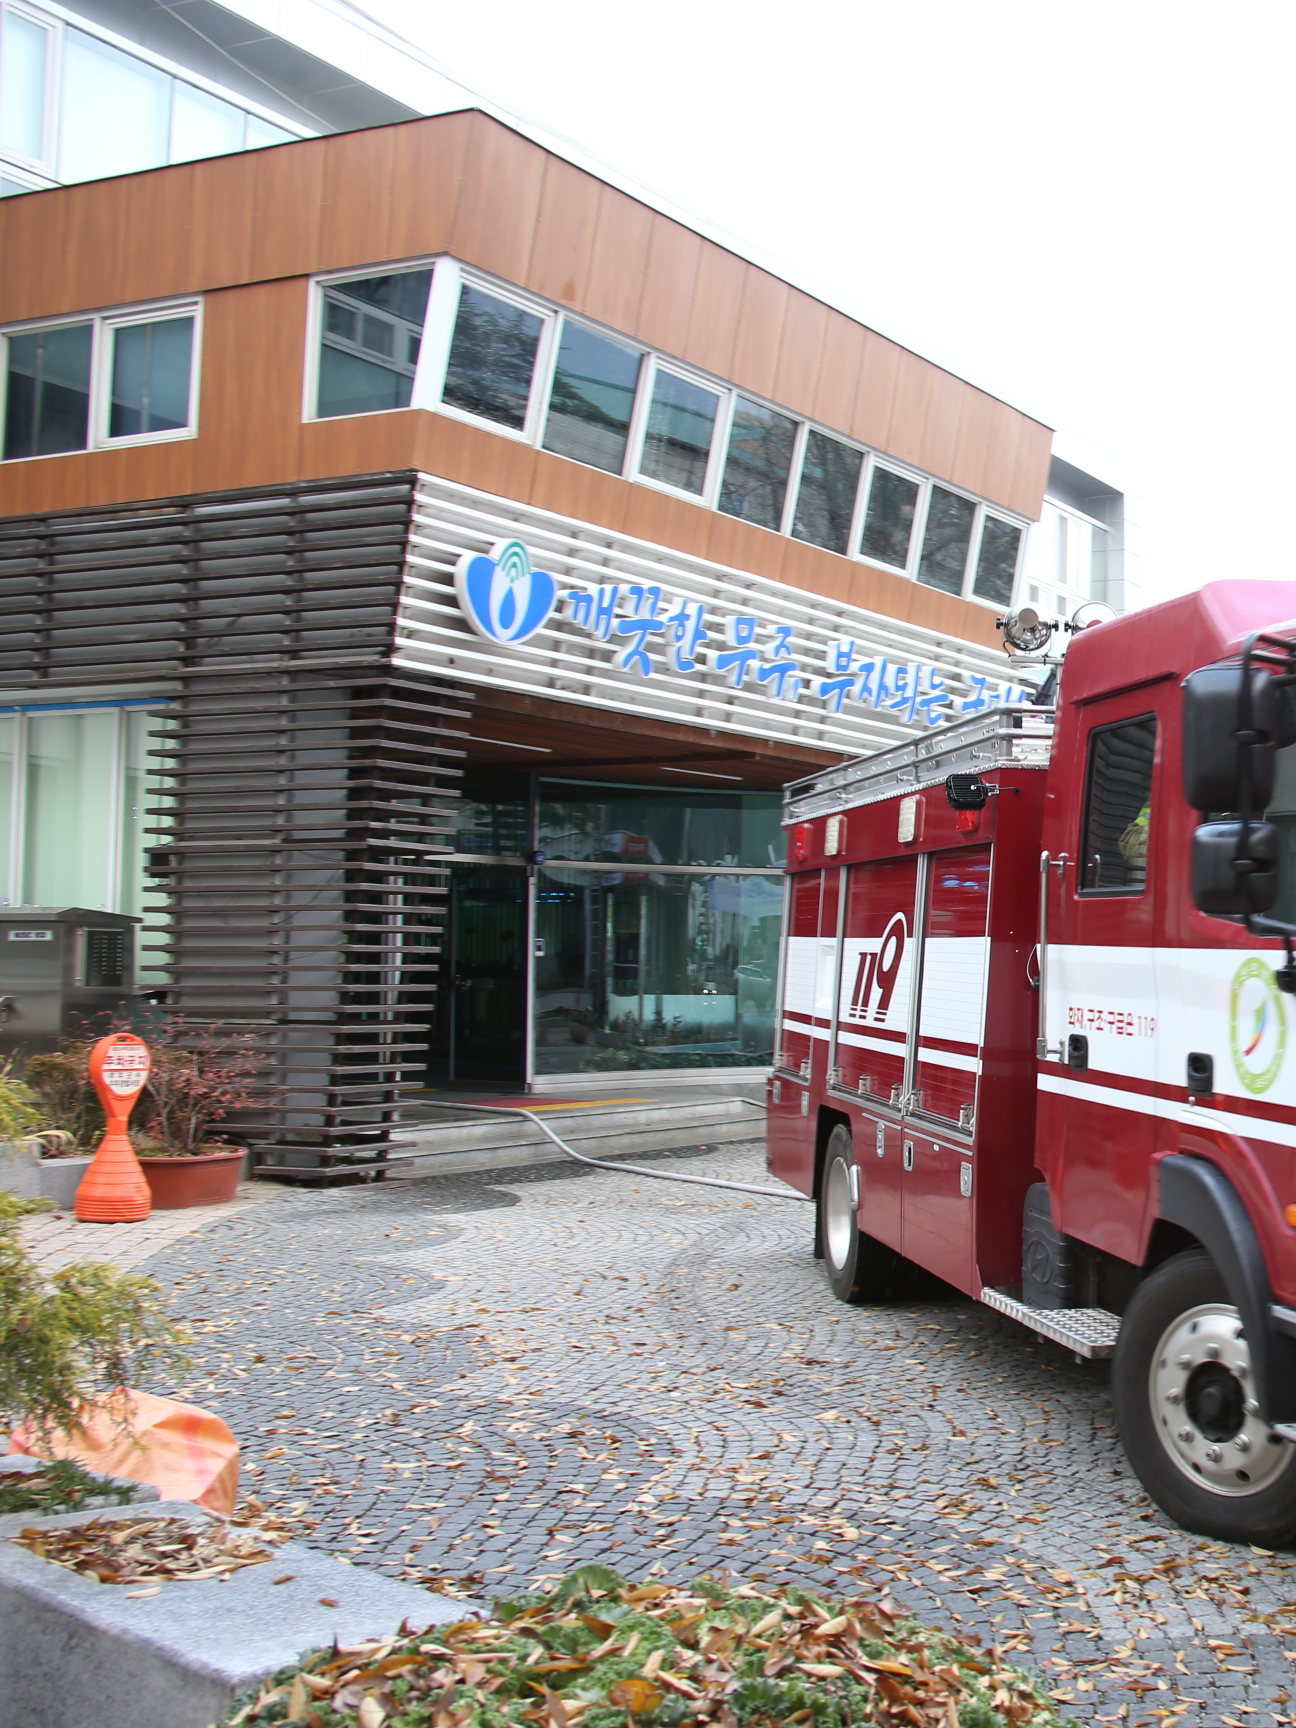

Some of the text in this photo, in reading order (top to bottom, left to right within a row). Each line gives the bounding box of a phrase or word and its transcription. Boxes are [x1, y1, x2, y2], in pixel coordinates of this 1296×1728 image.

[566, 585, 708, 677] 깨끗한
[818, 640, 950, 725] 부자되는
[849, 917, 905, 1023] 119
[1137, 1015, 1157, 1038] 119
